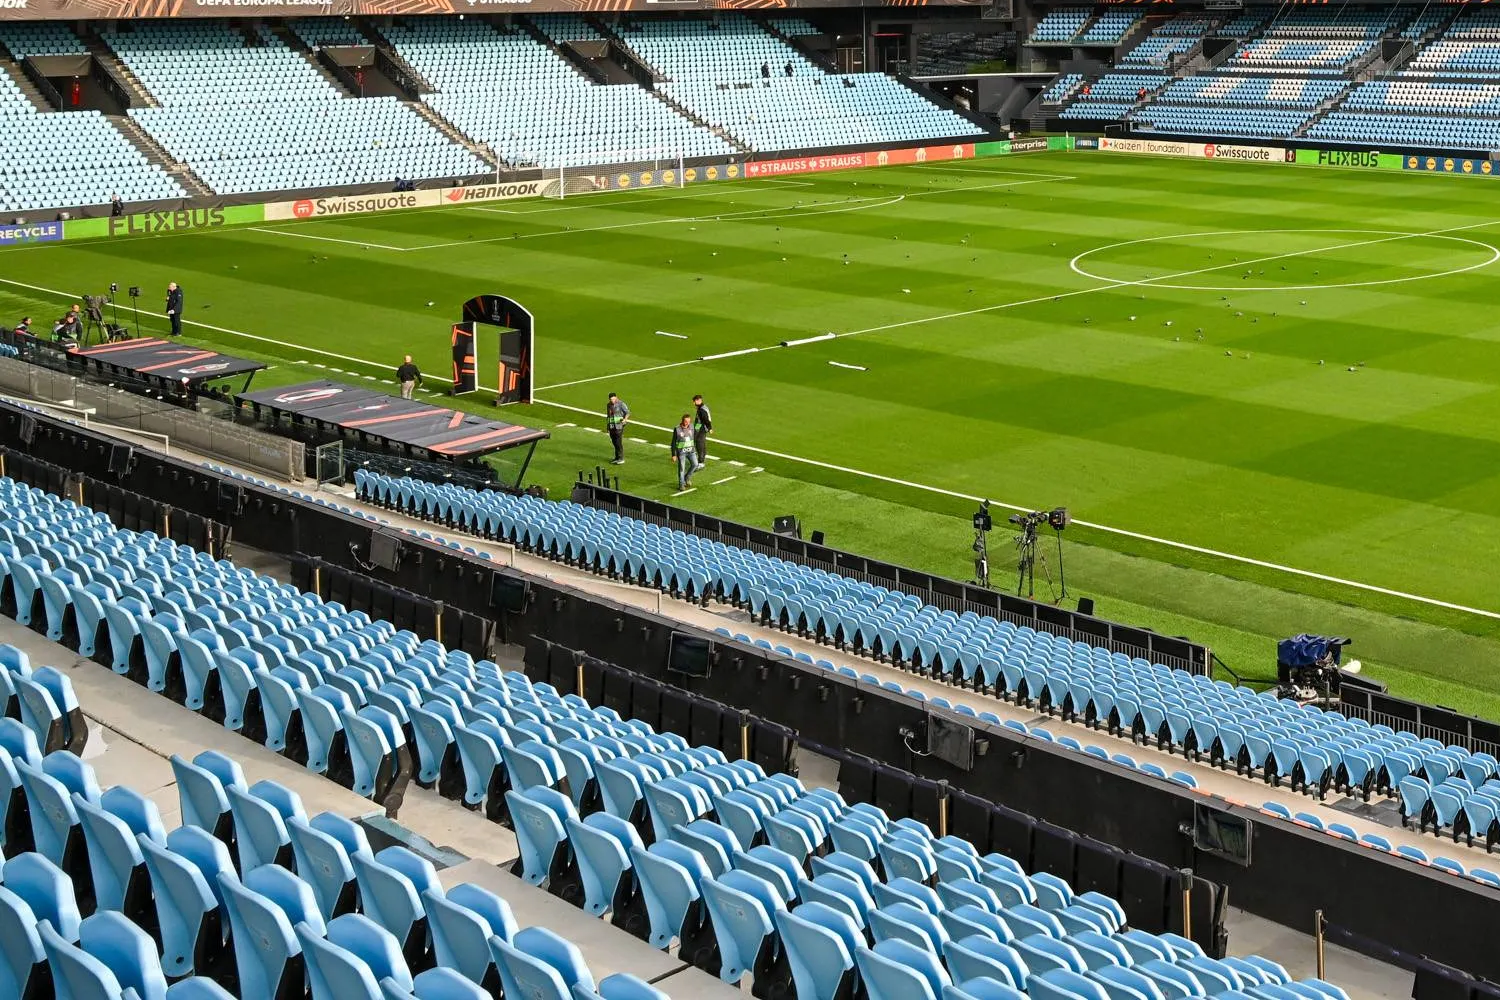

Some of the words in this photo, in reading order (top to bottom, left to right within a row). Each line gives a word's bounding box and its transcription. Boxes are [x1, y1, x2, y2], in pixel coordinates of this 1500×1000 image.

[1004, 140, 1047, 151] enterprise
[1113, 140, 1142, 151] kaizen
[1147, 142, 1184, 154] foundation
[1215, 145, 1270, 160] Swissquote
[761, 161, 807, 173] STRAUSS
[819, 155, 862, 169] STRAUSS
[316, 193, 416, 215] Swissquote
[0, 226, 57, 240] RECYCLE
